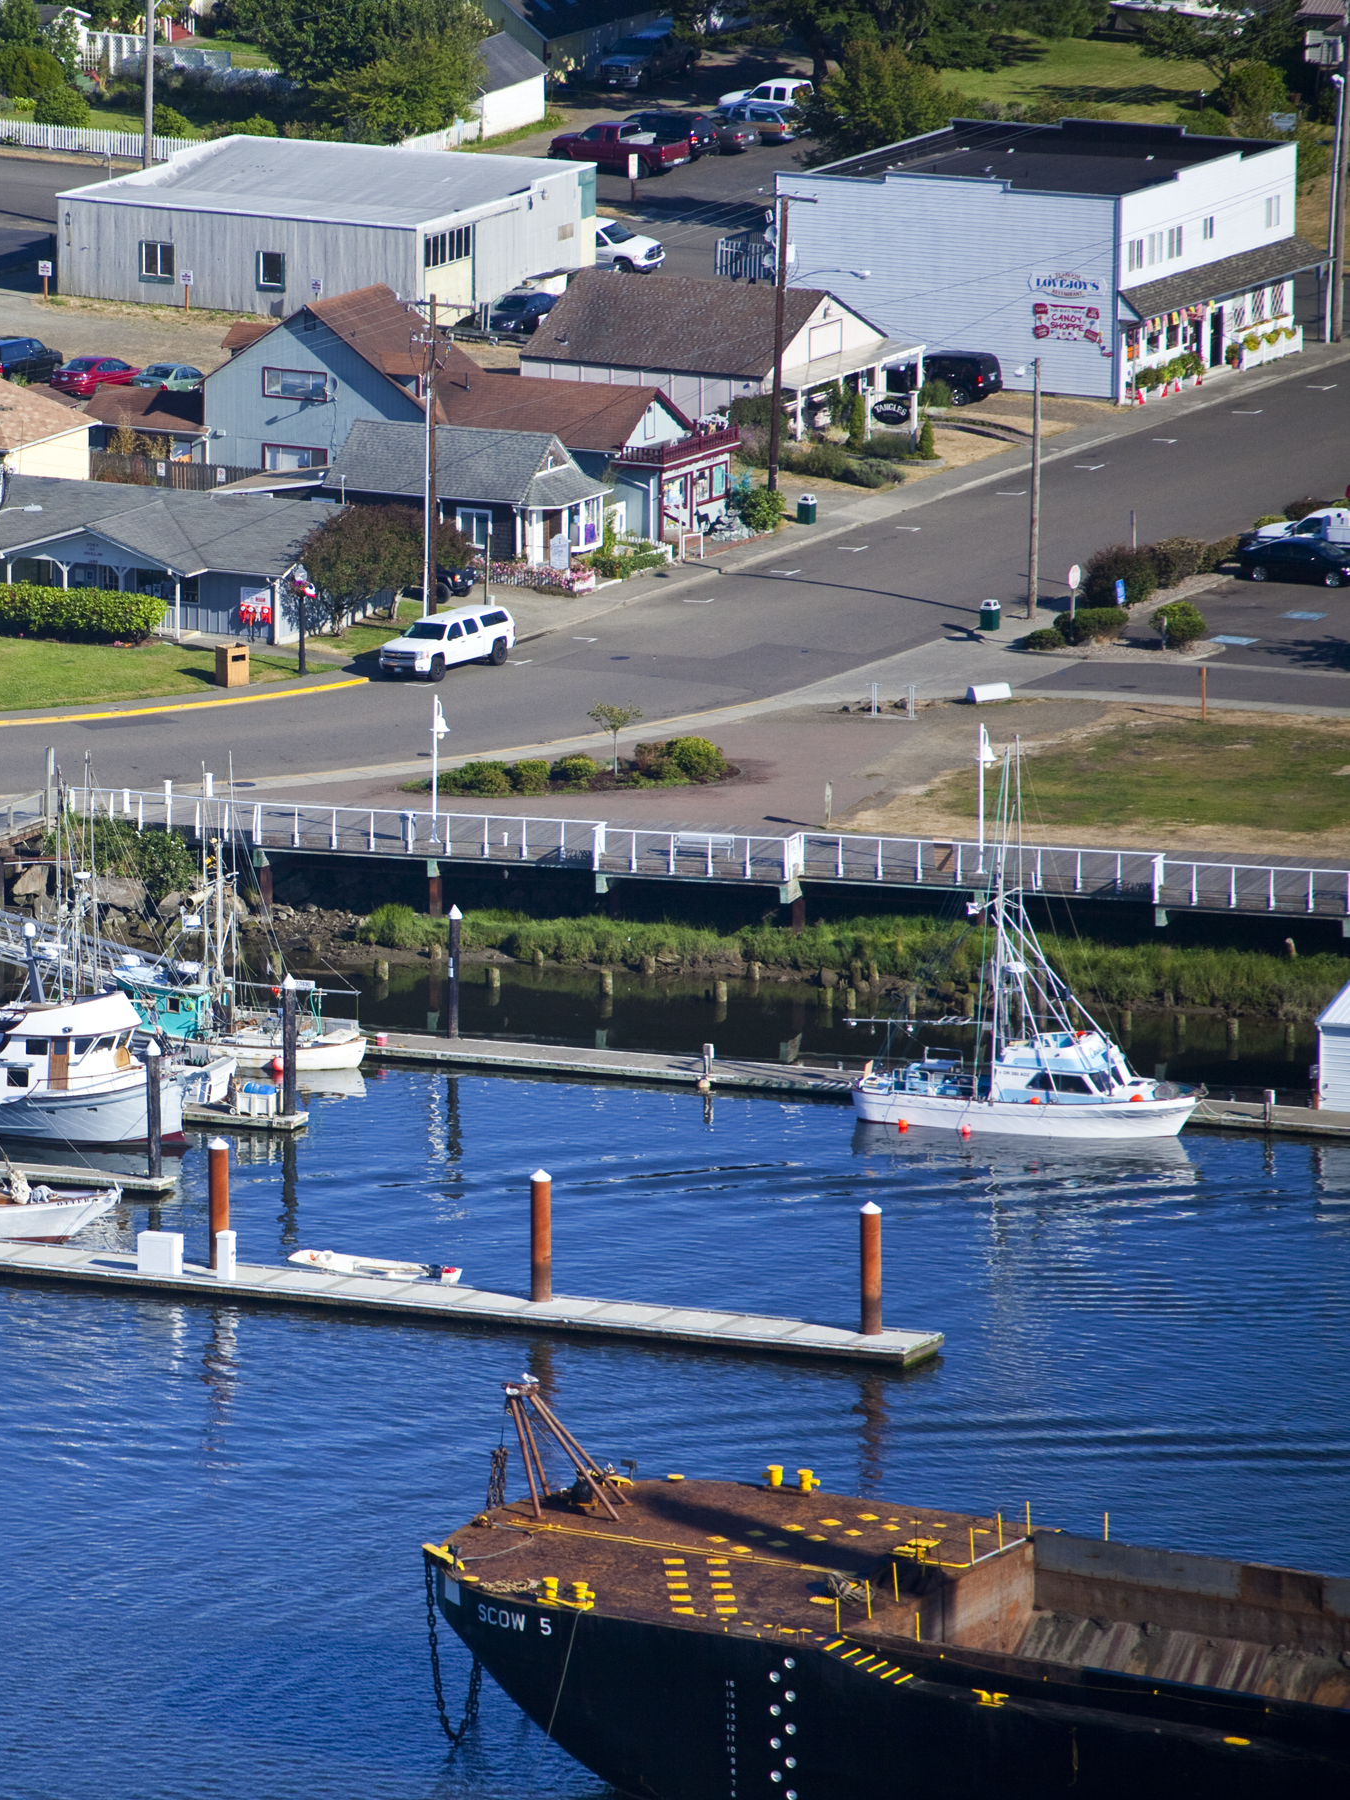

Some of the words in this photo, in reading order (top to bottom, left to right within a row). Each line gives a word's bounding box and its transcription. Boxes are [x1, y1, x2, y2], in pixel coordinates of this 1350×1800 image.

[1036, 278, 1100, 291] LOVEJOY'S
[1052, 289, 1083, 297] RESTAURANT
[1051, 313, 1082, 323] CANDY
[1050, 321, 1085, 332] SHOPPE
[873, 403, 908, 416] TANGLES
[478, 1603, 526, 1632] SCOW
[539, 1617, 552, 1636] 5
[725, 1680, 735, 1688] 16
[726, 1701, 735, 1709] 14
[726, 1723, 736, 1732] 12
[726, 1734, 735, 1742] 11
[726, 1745, 736, 1754] 10
